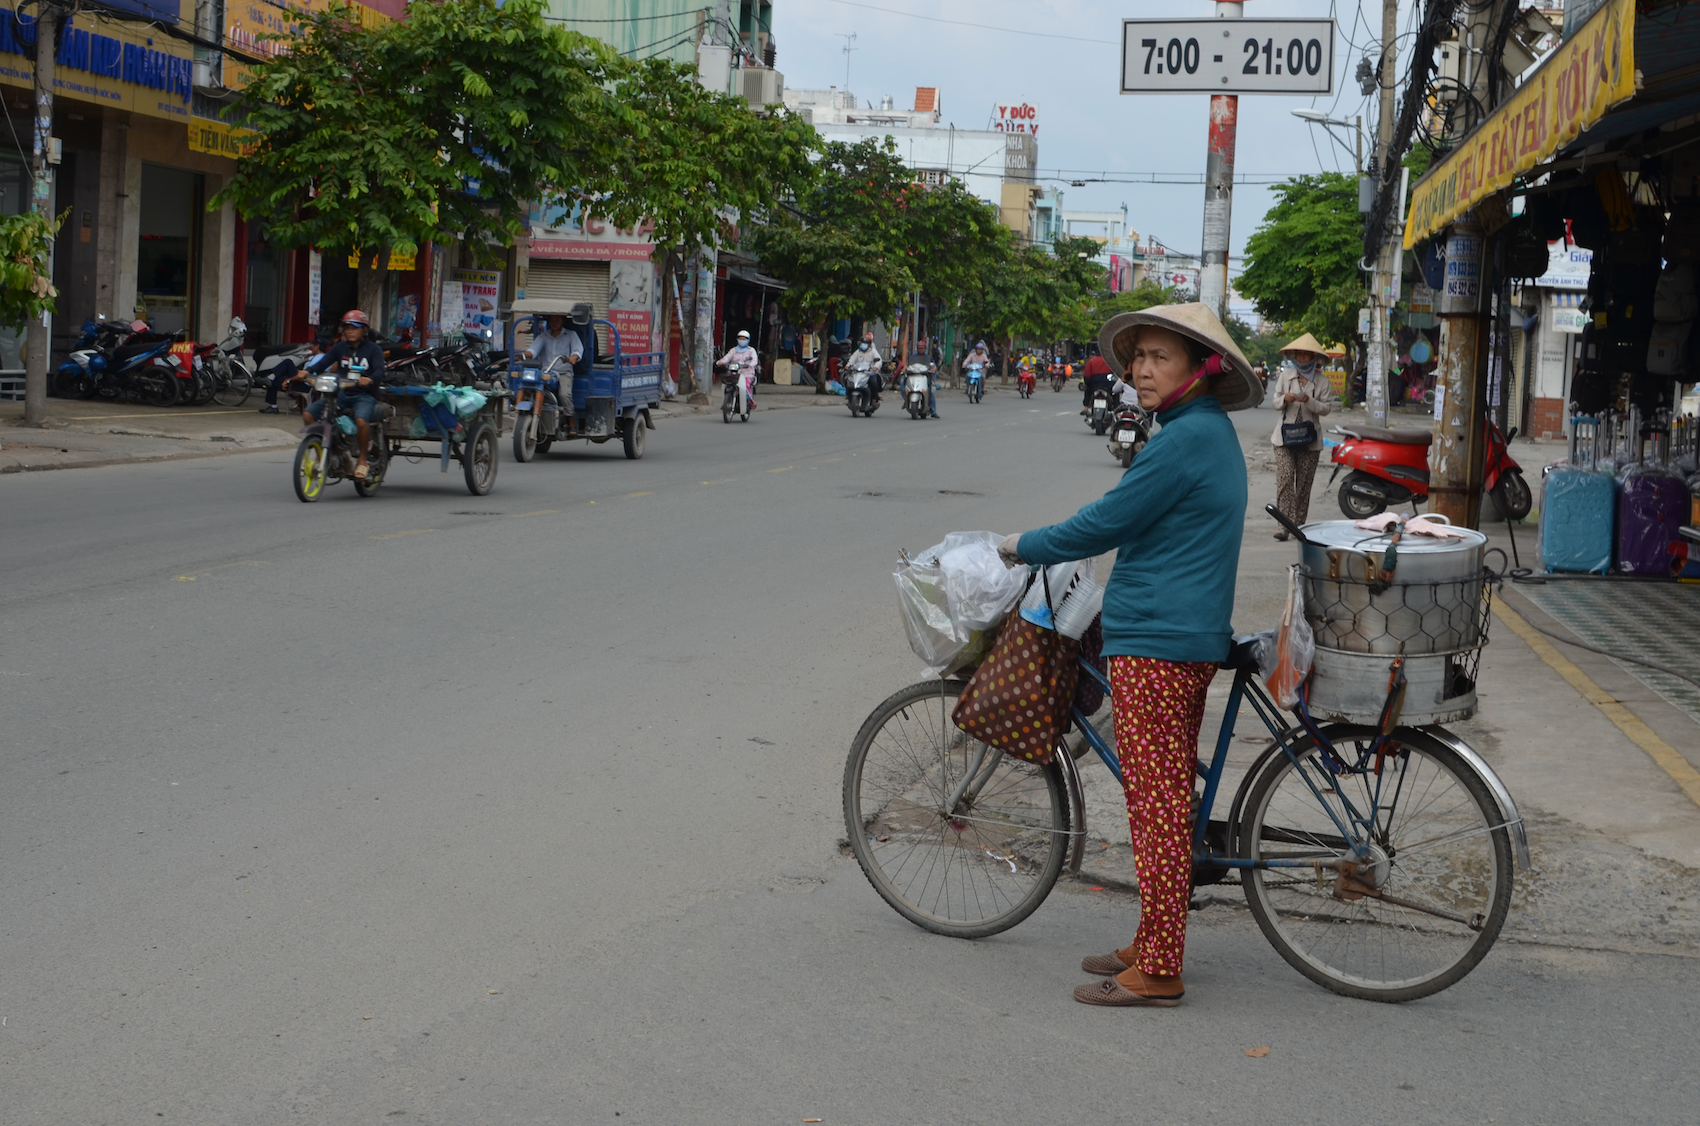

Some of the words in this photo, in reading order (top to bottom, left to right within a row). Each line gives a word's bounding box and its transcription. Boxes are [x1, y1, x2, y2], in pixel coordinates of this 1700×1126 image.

[1141, 38, 1200, 74] 7:00
[1242, 38, 1322, 76] 21:00
[999, 106, 1007, 118] Y
[1010, 102, 1036, 120] ĐỨC
[1006, 136, 1023, 150] NHA
[1006, 154, 1028, 169] KHOA
[473, 286, 496, 296] TRANG
[630, 324, 649, 332] NAM
